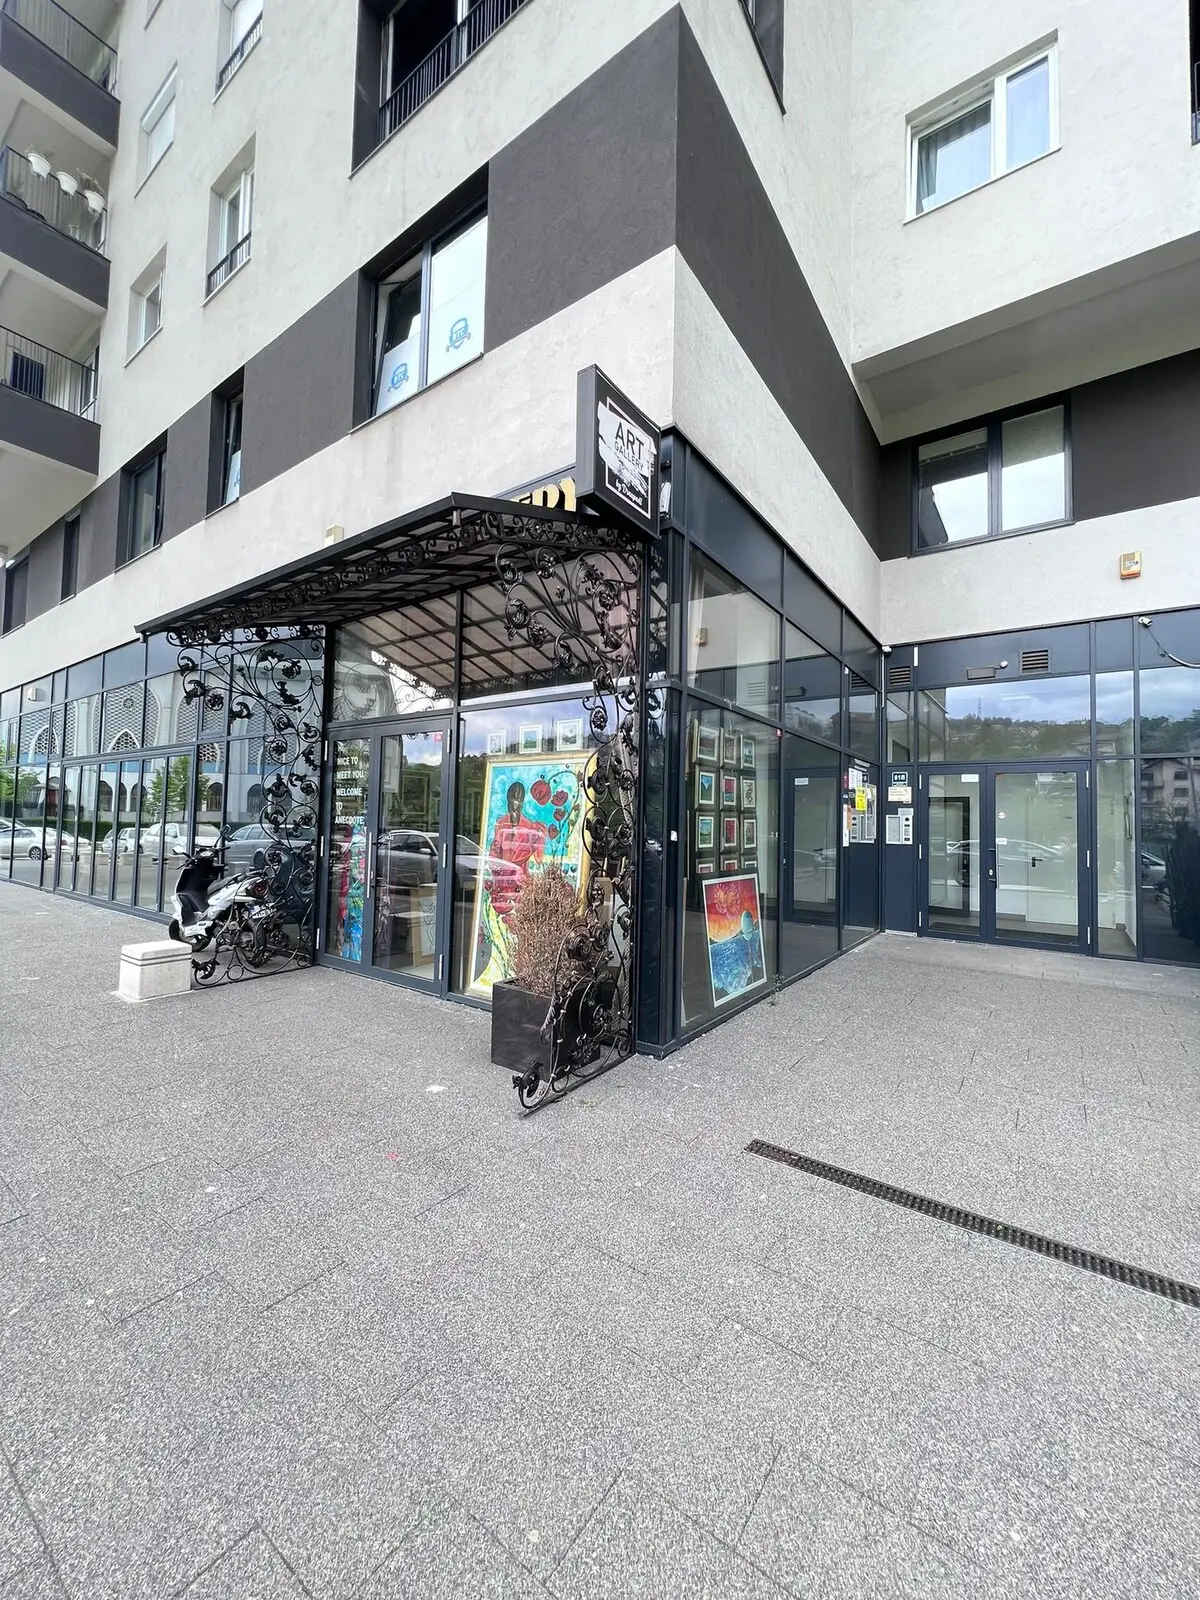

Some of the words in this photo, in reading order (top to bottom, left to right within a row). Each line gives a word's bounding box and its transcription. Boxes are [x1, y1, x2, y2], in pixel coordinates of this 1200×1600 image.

[614, 421, 644, 460] ART
[614, 440, 644, 471] GALLERY
[337, 757, 349, 765] NICE
[351, 757, 358, 765] TO
[336, 771, 350, 779] MEET
[336, 788, 362, 796] WELCOME
[335, 802, 343, 810] TO
